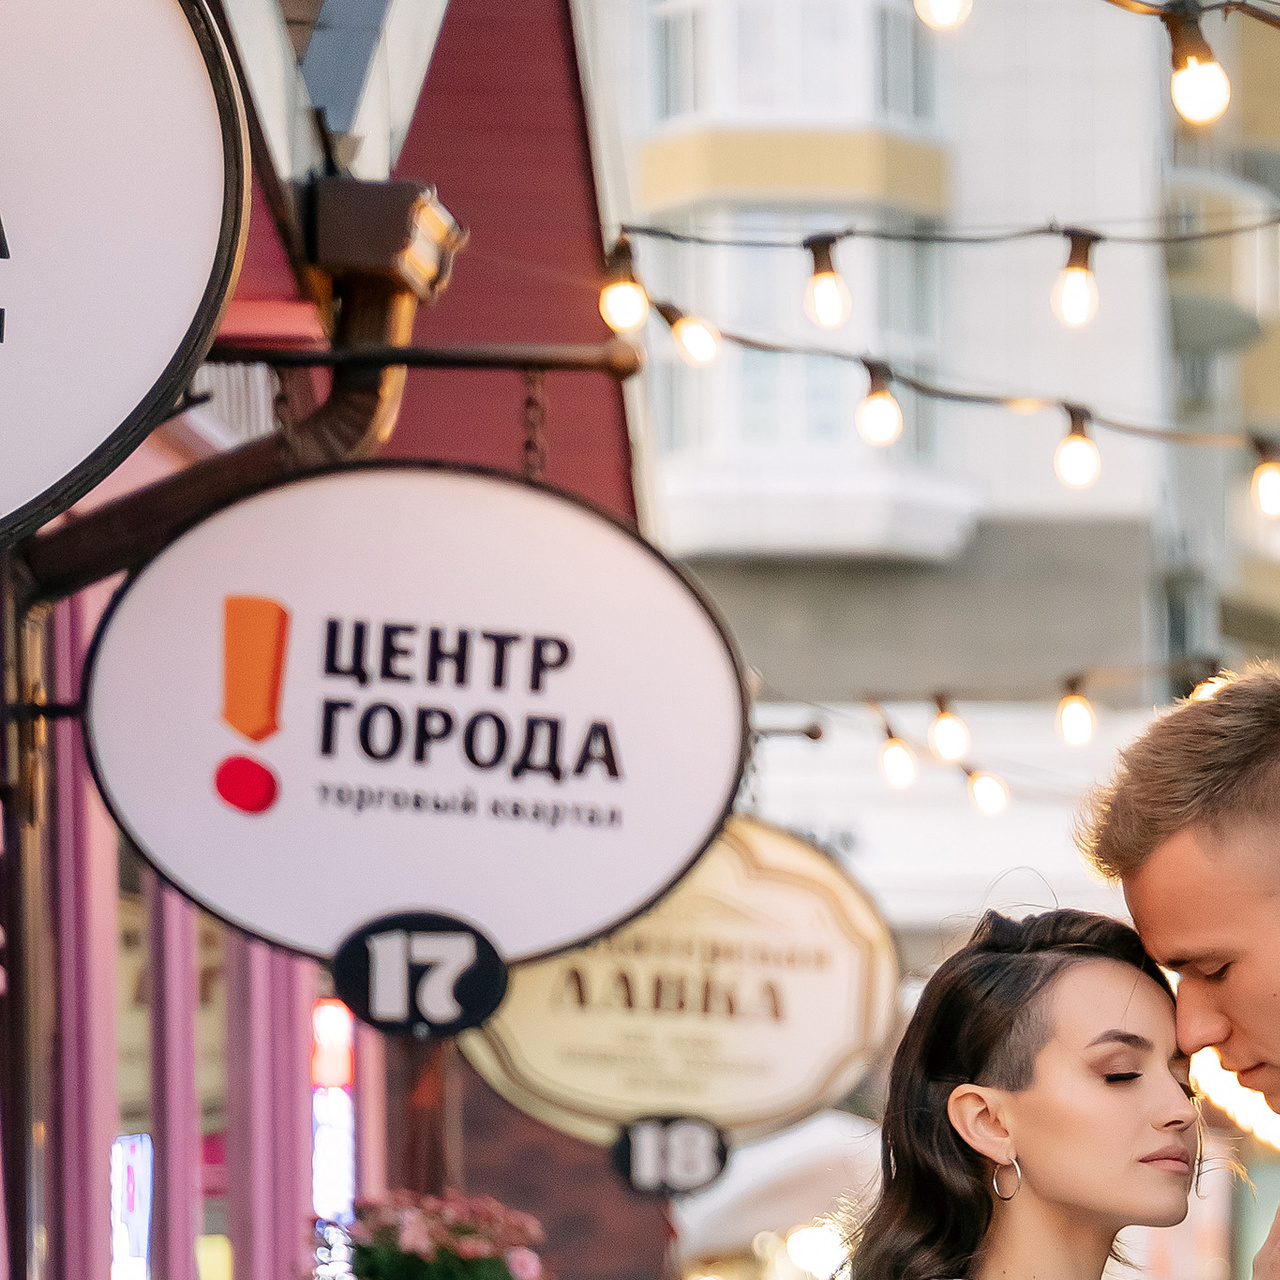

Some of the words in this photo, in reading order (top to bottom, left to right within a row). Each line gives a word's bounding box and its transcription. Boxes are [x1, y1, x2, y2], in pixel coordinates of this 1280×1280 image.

[324, 618, 572, 692] ЦЕНТР
[320, 698, 622, 783] ГОРОДА
[318, 783, 478, 815] торговый
[491, 796, 622, 828] квартал
[364, 929, 478, 1024] 17
[628, 1120, 721, 1191] 18
